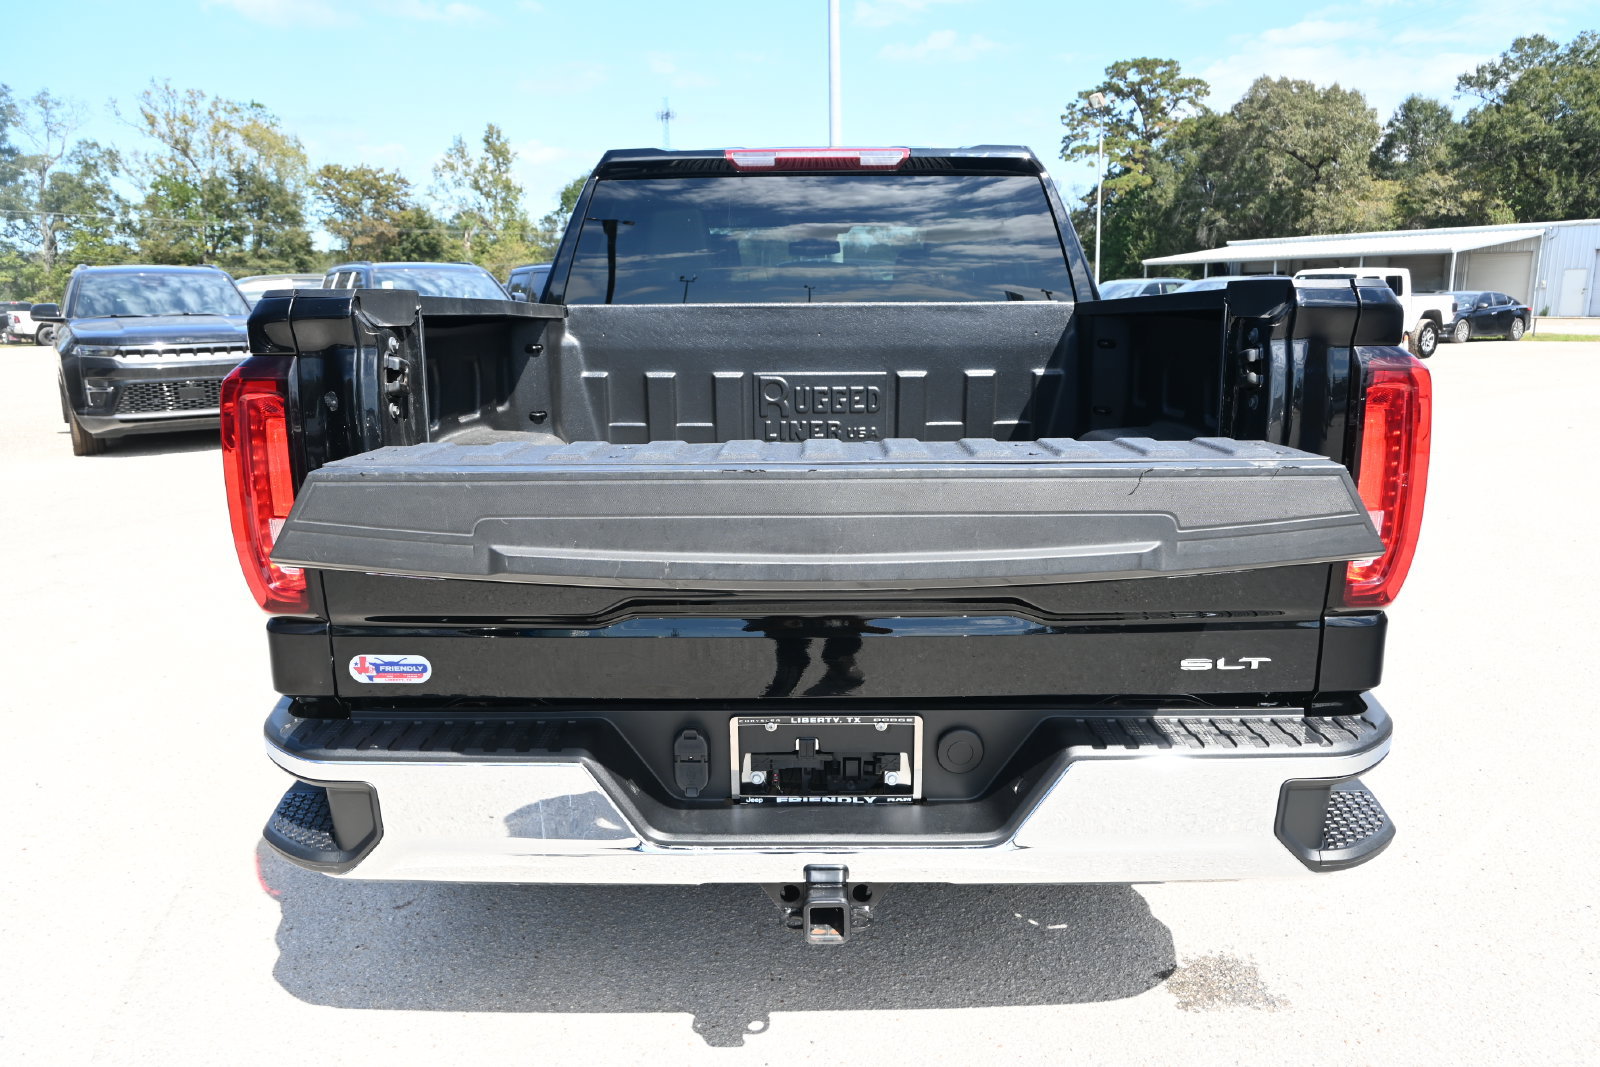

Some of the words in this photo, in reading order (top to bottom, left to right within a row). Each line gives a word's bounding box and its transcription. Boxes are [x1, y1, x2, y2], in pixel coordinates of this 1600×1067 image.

[759, 376, 880, 418] RUGGED
[765, 420, 842, 440] LINER
[846, 426, 879, 440] USA
[1180, 657, 1272, 671] SLT
[745, 796, 764, 804] Jeep
[776, 796, 877, 804] FRIENDLY
